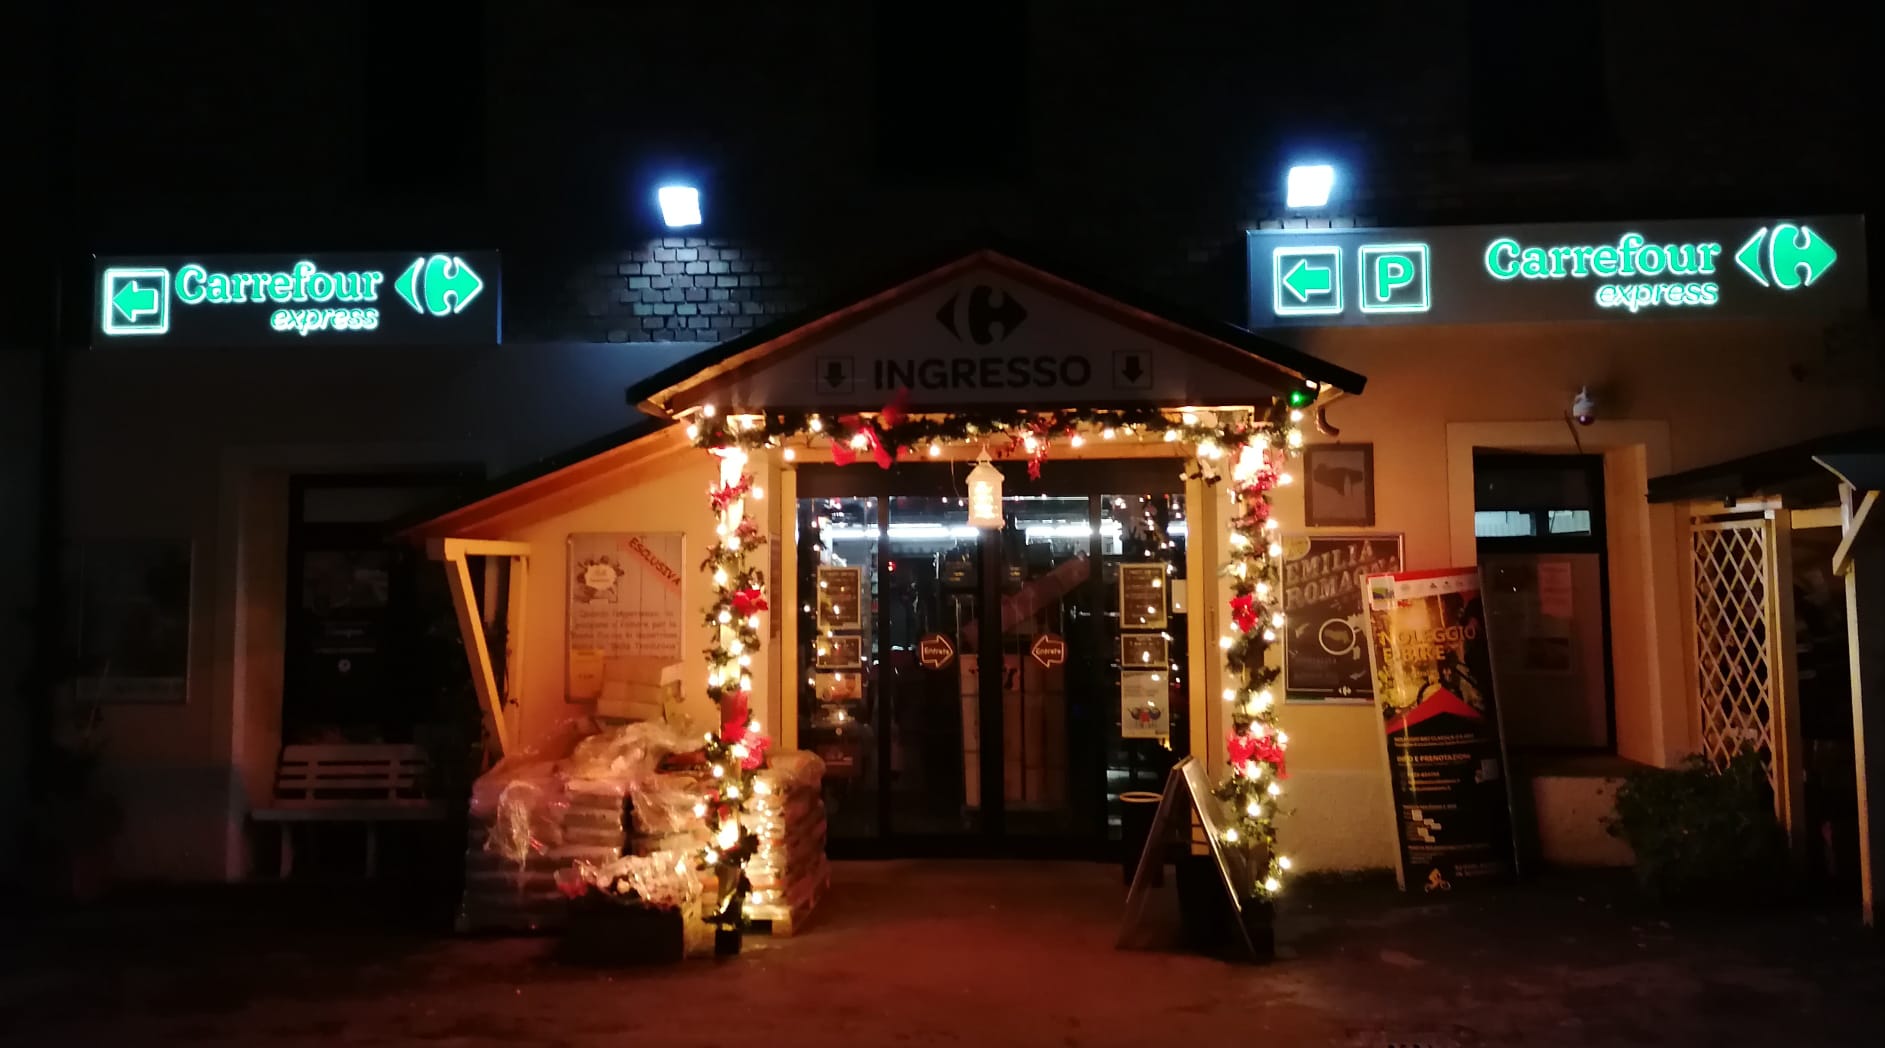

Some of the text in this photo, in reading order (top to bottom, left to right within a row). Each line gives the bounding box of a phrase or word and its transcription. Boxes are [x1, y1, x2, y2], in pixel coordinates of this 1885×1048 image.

[1375, 255, 1415, 302] P
[1485, 233, 1721, 281] Carrefour
[174, 260, 383, 305] Carrefour
[1596, 281, 1720, 311] express
[270, 307, 380, 336] express
[874, 355, 1091, 390] INGRESSO
[628, 536, 681, 587] ESCLUSIVA
[1286, 539, 1374, 587] EMILIA
